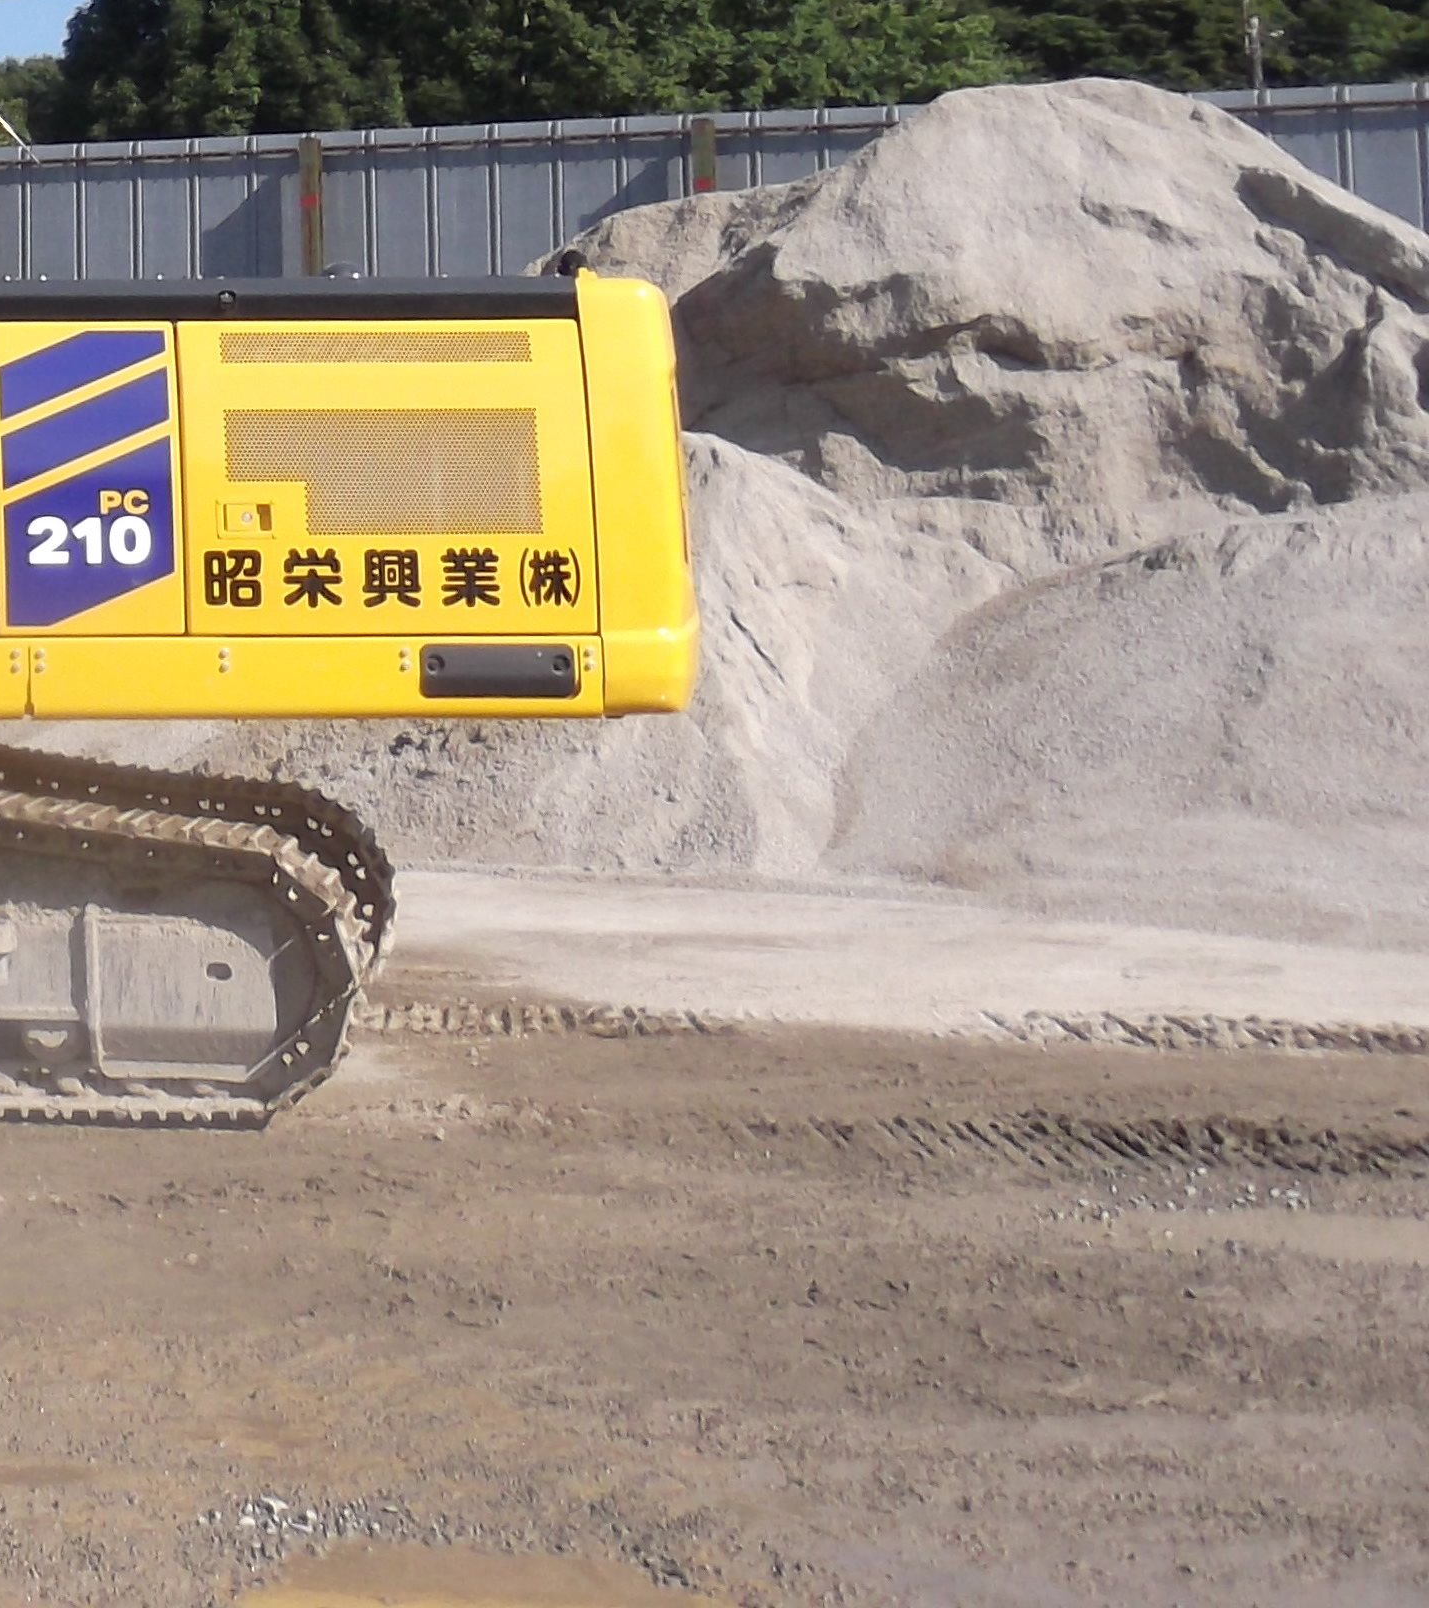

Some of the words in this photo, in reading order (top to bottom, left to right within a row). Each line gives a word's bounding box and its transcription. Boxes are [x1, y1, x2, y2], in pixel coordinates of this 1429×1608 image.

[99, 489, 150, 515] PC
[27, 515, 152, 565] 210
[203, 547, 582, 608] 昭栄興業(株)
